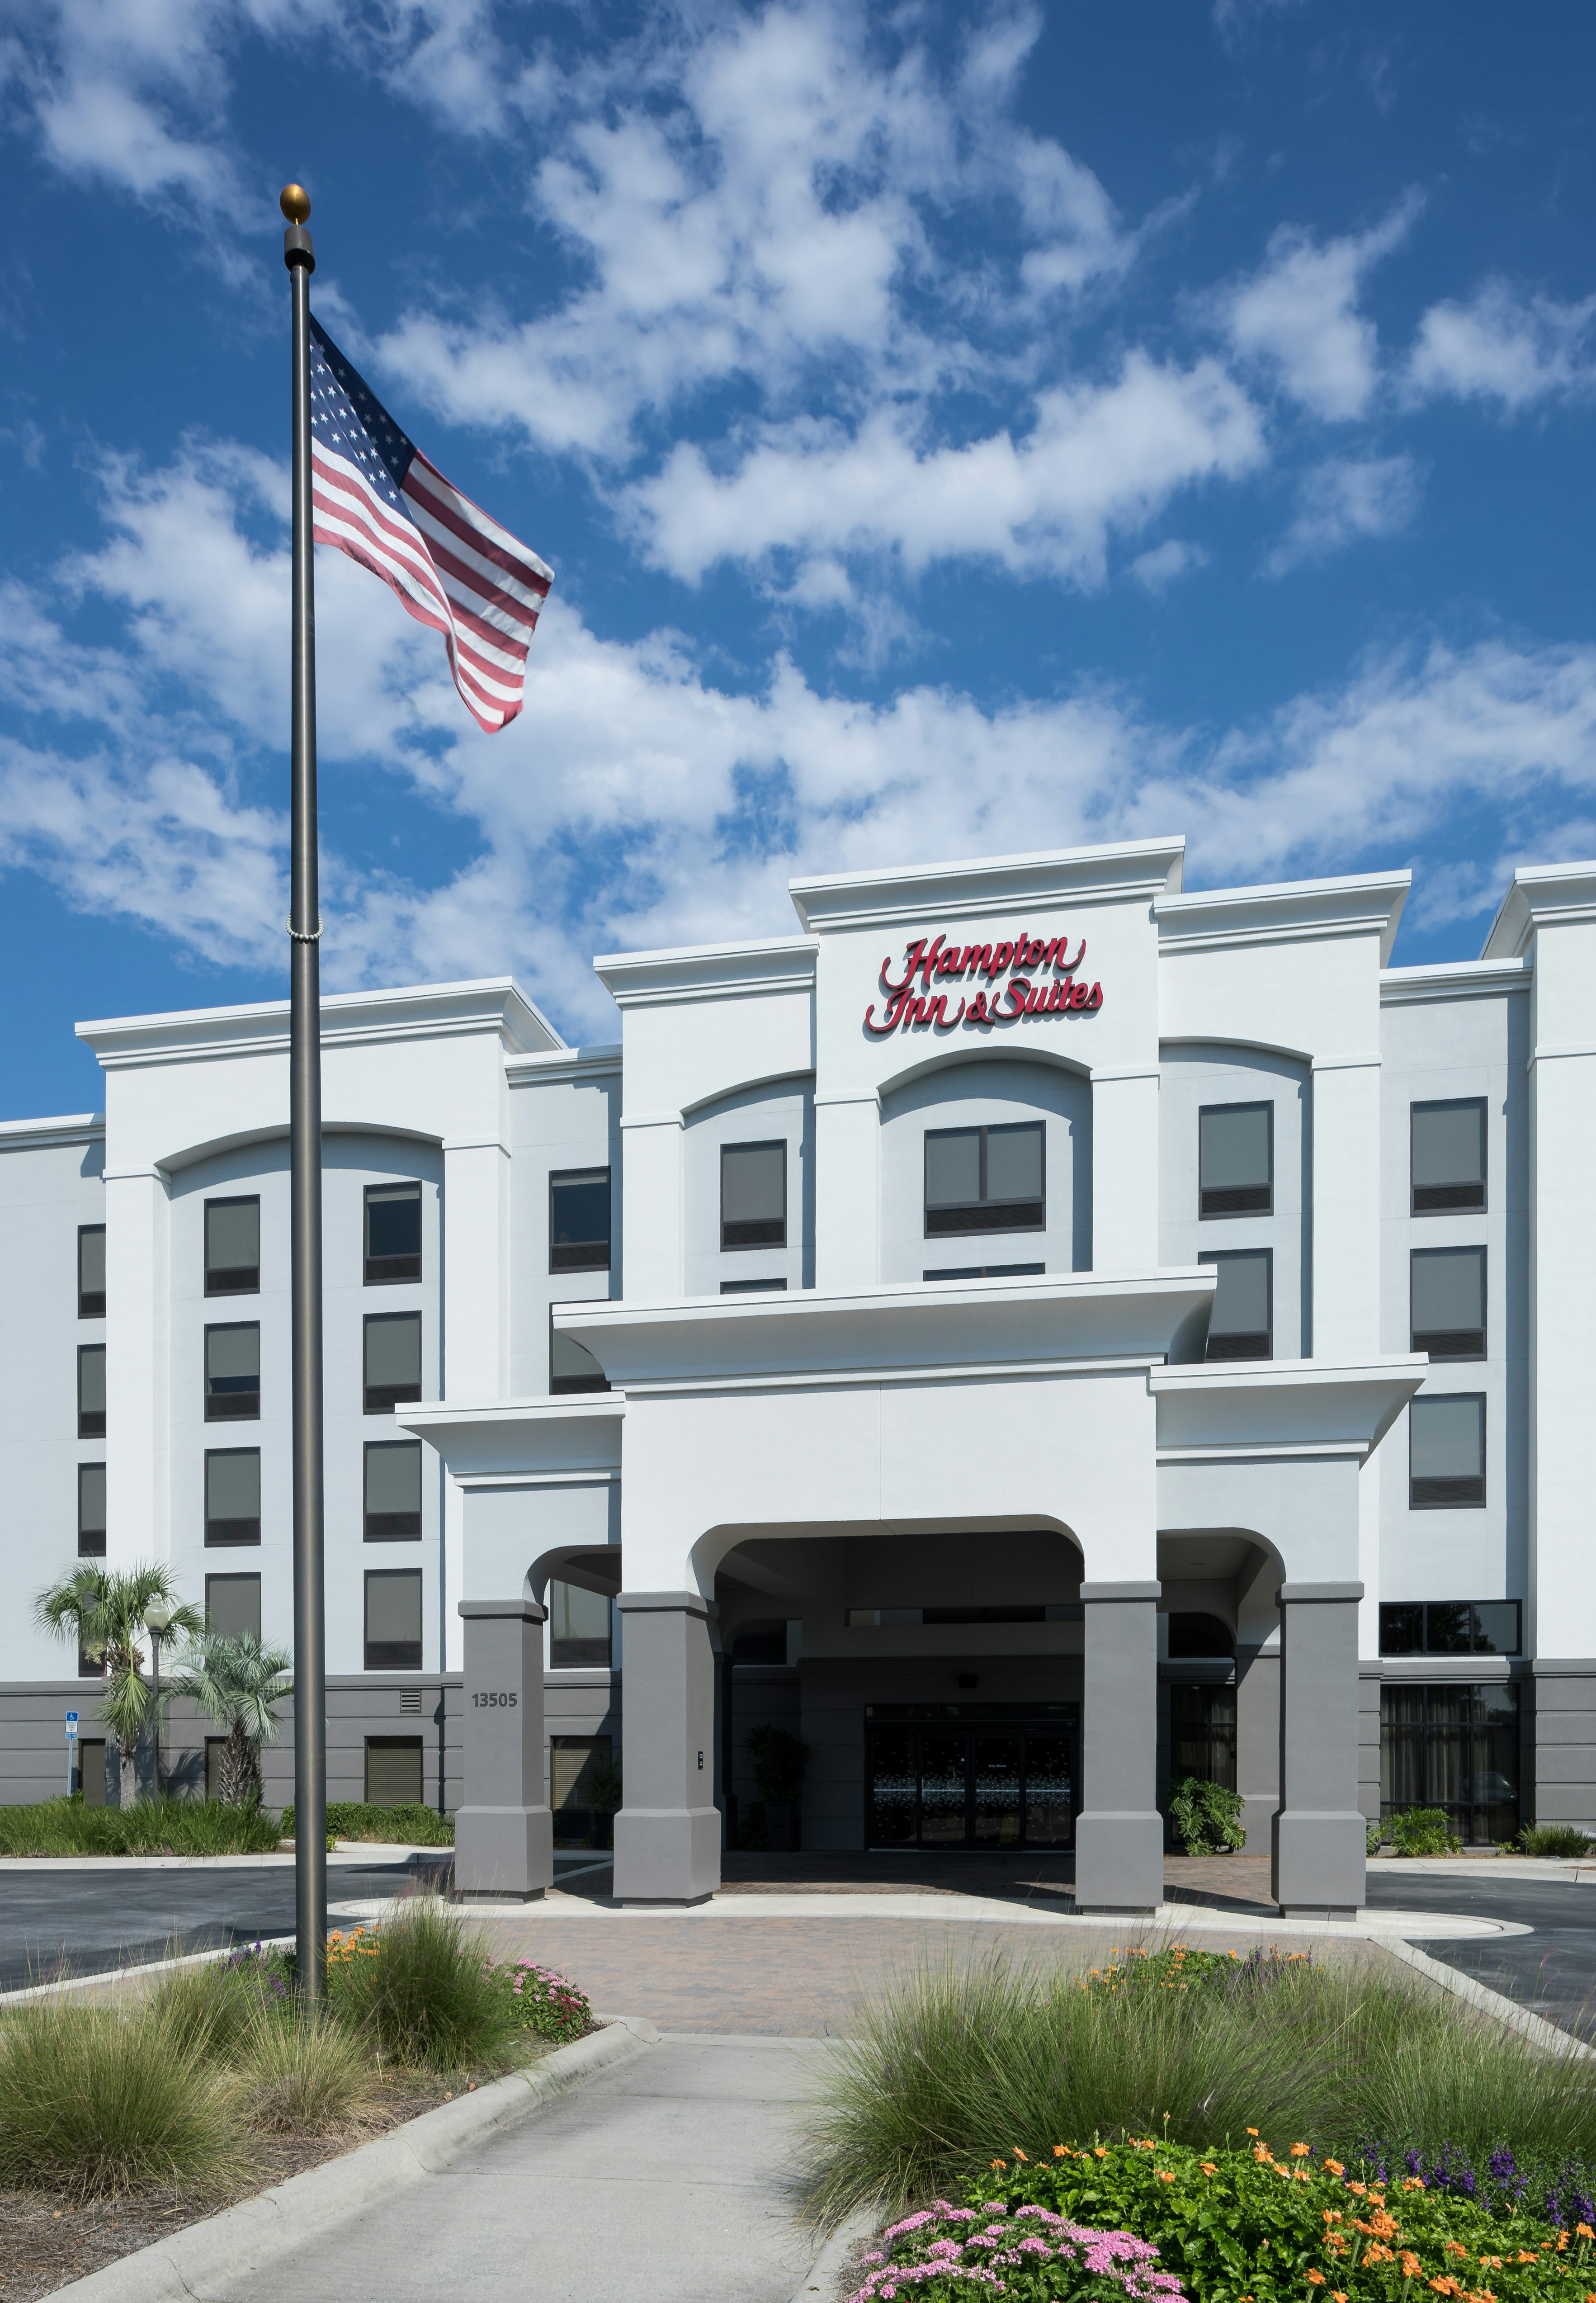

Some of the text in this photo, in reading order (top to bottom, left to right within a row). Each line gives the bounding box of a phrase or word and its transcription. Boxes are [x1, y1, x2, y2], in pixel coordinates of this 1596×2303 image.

[882, 932, 1086, 990] Hampton
[865, 976, 1103, 1033] Inn & Suites
[472, 1693, 518, 1707] 13505
